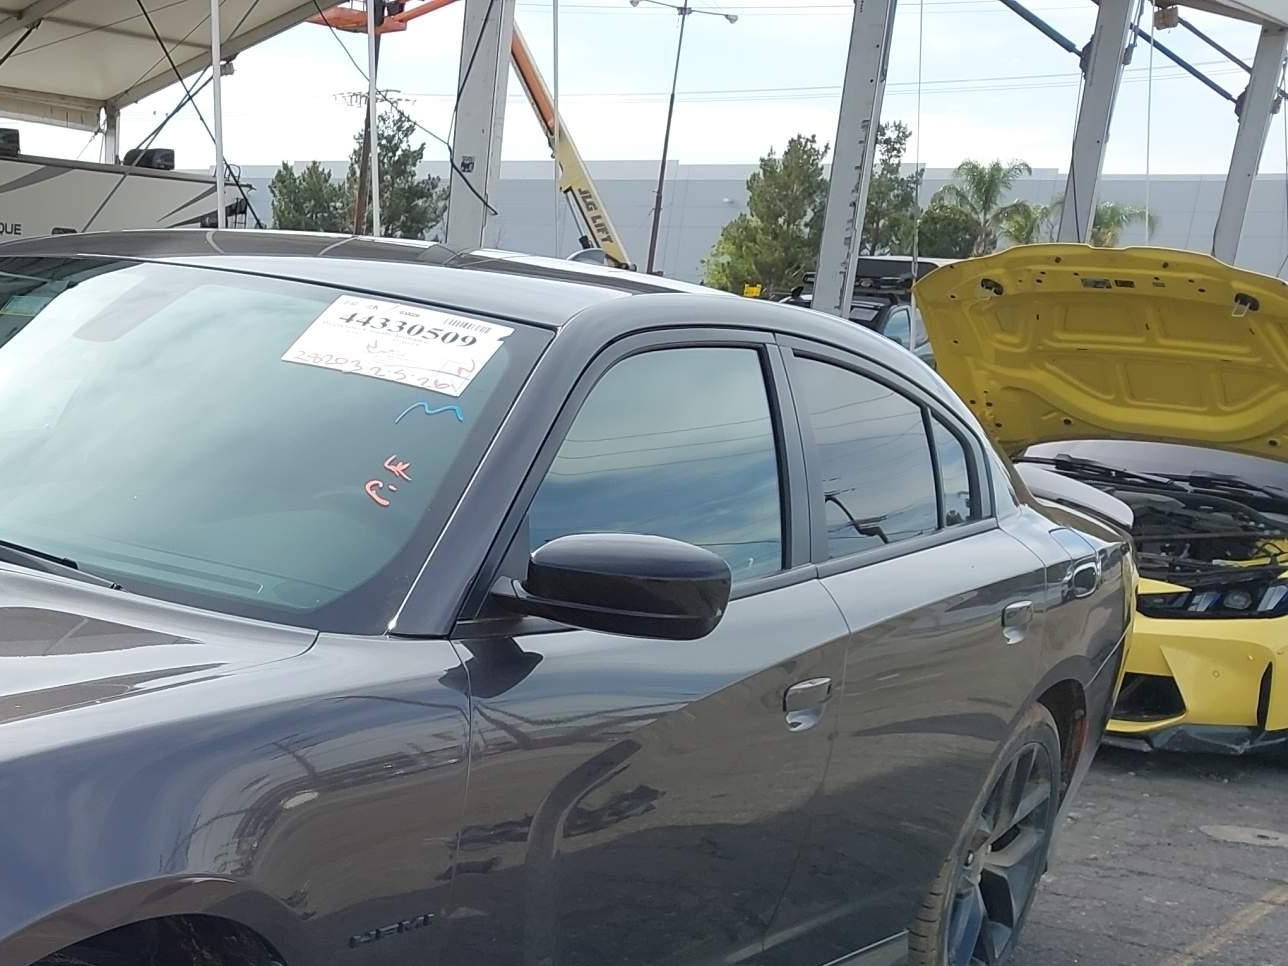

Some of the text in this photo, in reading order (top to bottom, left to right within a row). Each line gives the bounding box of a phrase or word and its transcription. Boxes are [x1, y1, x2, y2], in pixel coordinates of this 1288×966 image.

[578, 187, 614, 243] JLG LIFT
[338, 312, 477, 347] 44330509
